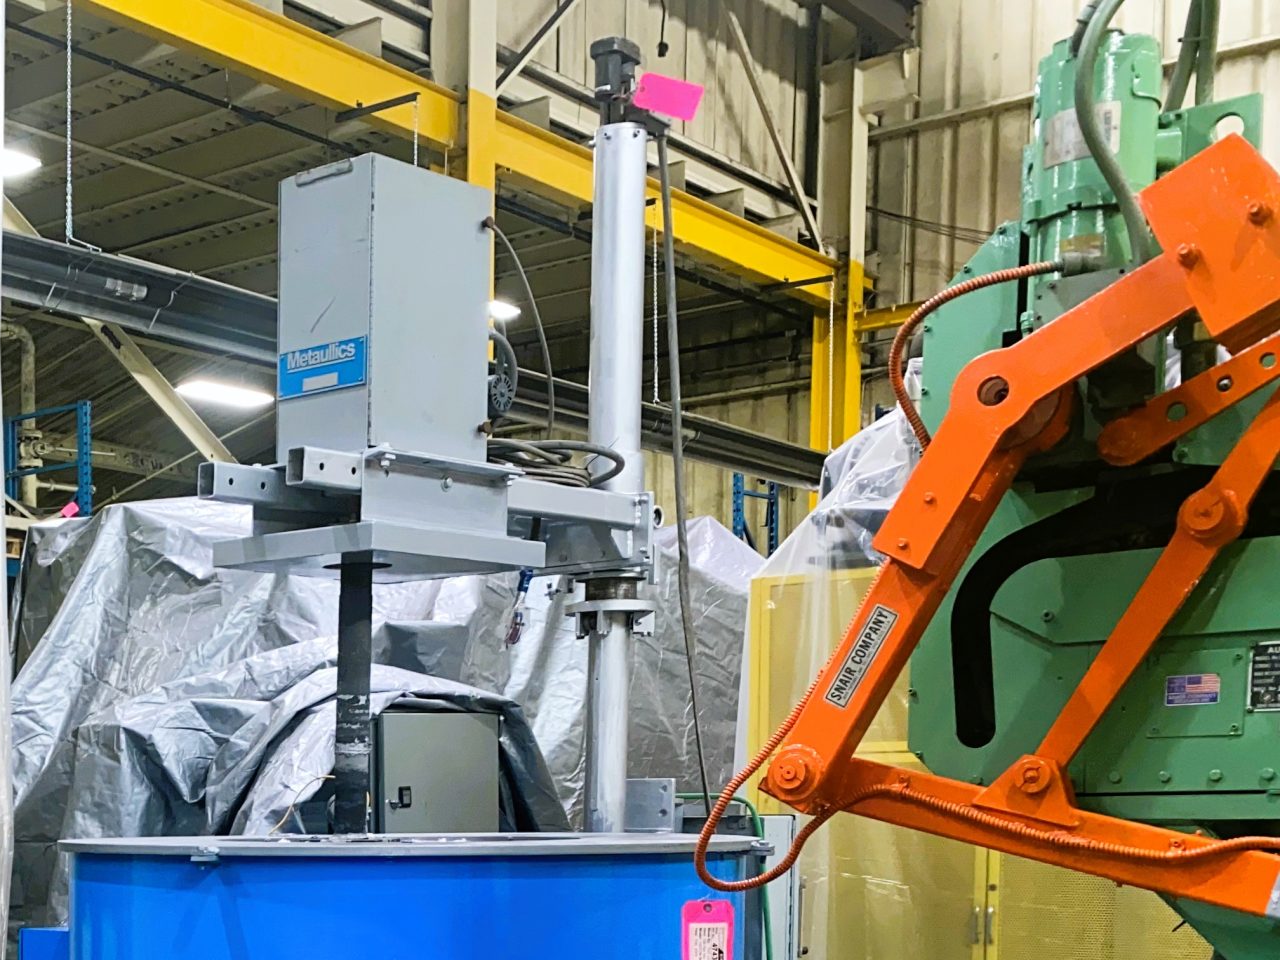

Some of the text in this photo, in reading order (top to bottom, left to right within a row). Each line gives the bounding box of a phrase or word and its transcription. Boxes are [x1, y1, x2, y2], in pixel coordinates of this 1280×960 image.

[287, 343, 356, 369] Metaullics
[831, 611, 888, 701] SNAIR COMPANY
